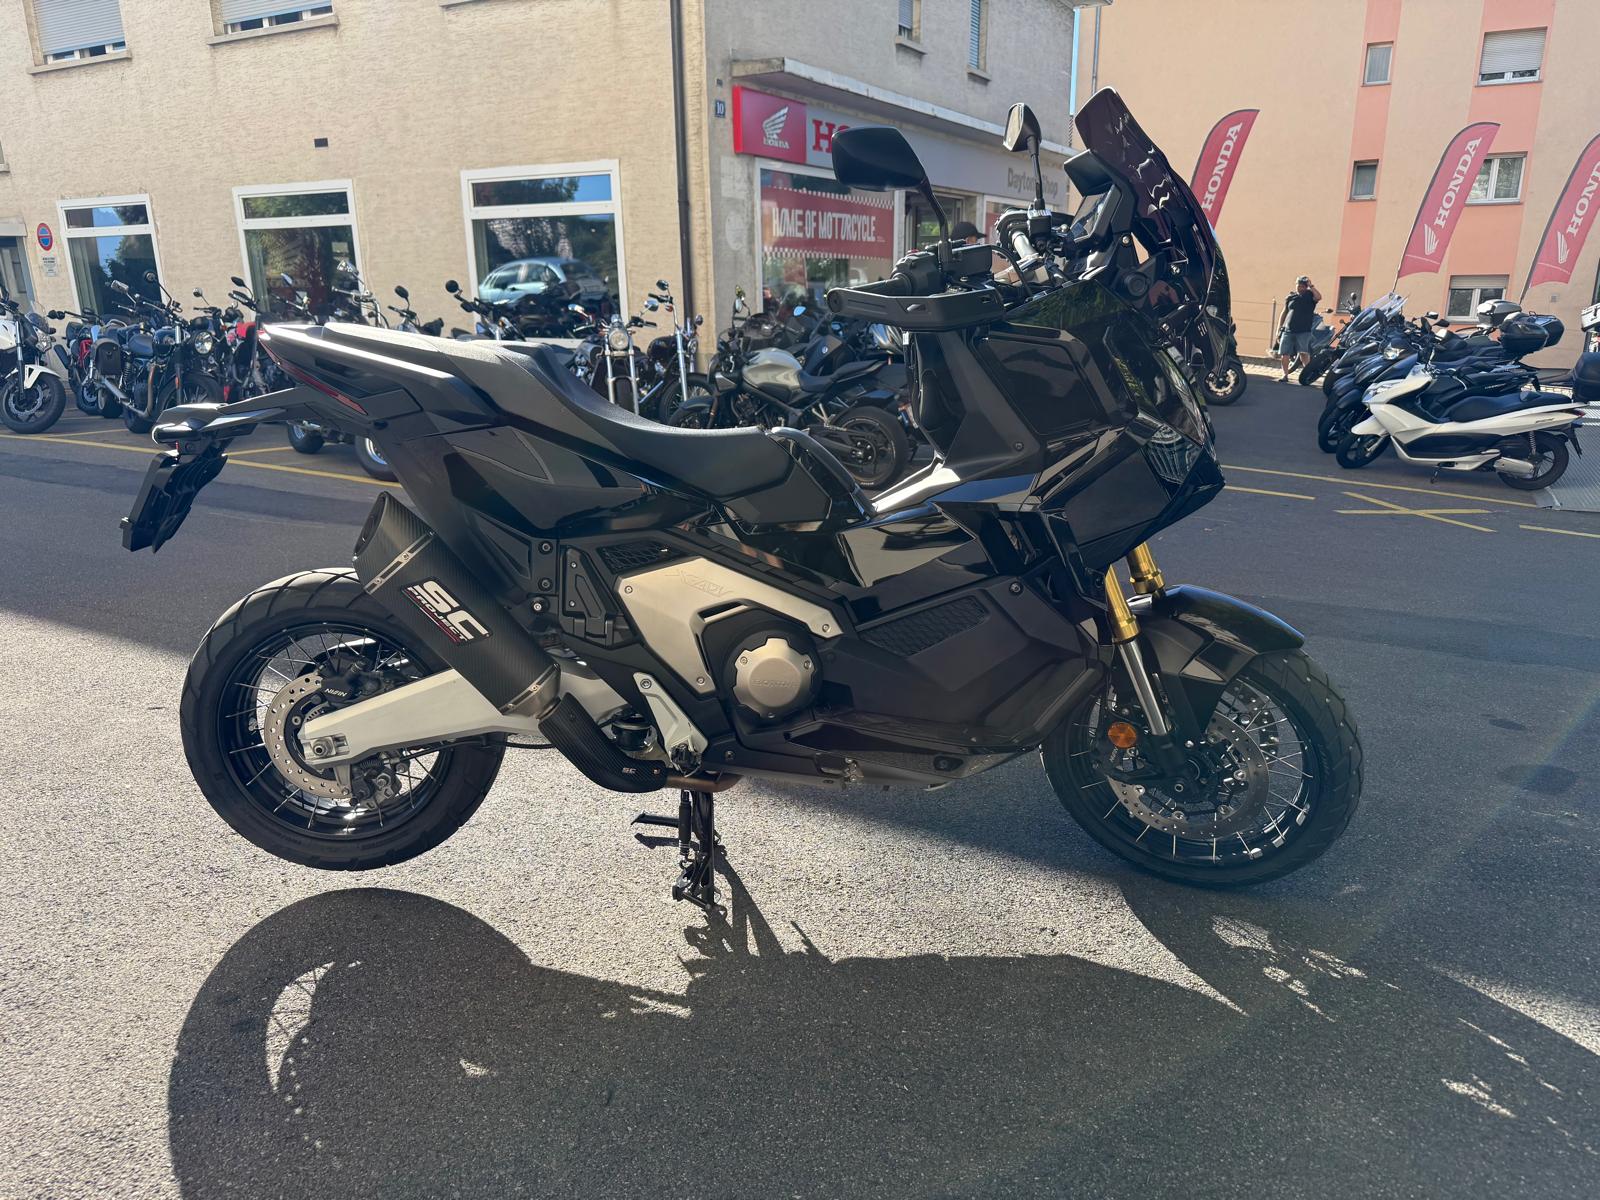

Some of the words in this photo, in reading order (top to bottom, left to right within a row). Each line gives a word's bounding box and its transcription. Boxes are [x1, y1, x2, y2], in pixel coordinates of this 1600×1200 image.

[716, 101, 725, 115] 10
[763, 136, 790, 149] HONDA
[1008, 167, 1038, 193] Dayton
[1201, 122, 1243, 212] HONDA
[1434, 137, 1482, 229] HONDA
[1566, 160, 1600, 237] HOND
[772, 207, 803, 238] HOME
[804, 209, 817, 239] OF
[413, 580, 489, 641] SC
